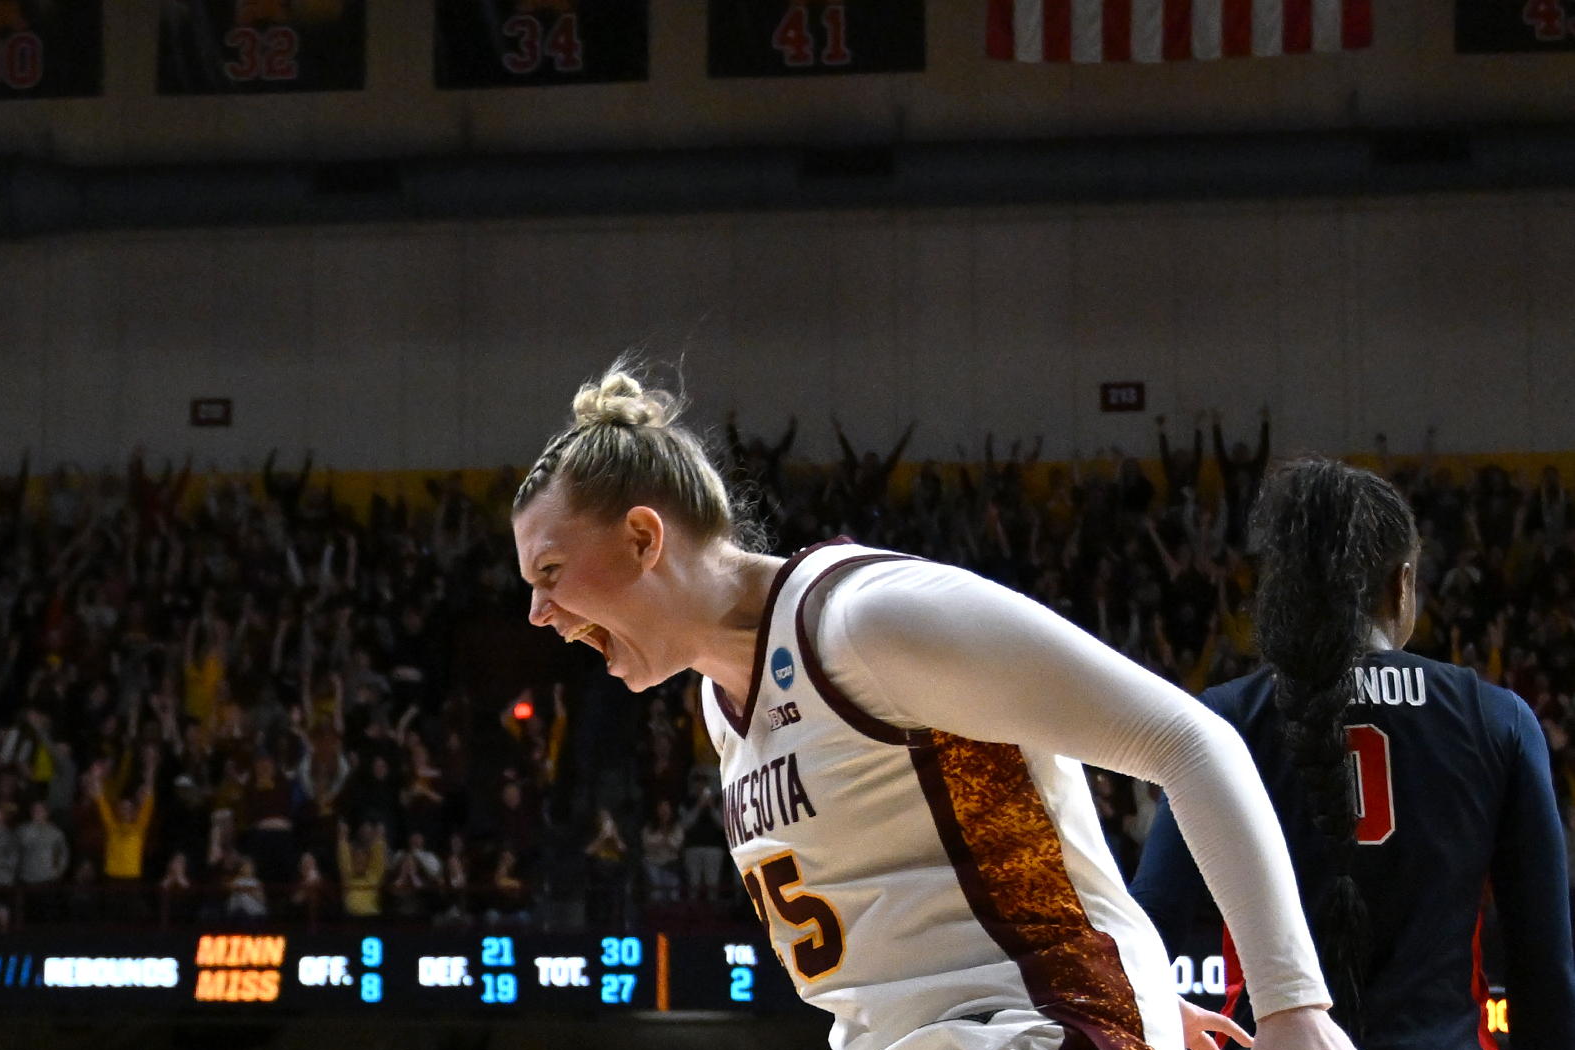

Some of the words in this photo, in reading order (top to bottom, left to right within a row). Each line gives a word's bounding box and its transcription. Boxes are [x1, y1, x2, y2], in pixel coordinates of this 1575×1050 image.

[224, 25, 299, 81] 32
[501, 13, 583, 74] 34
[771, 3, 852, 67] 41
[1348, 666, 1427, 706] NOU
[195, 935, 285, 967] MINN
[361, 937, 384, 967] 9
[481, 937, 516, 967] 21
[600, 936, 642, 967] 30
[44, 957, 178, 988] REBOUNDS
[418, 956, 474, 987] DEF.
[534, 957, 591, 987] TOT.
[194, 970, 281, 1001] MISS
[361, 972, 384, 1003] 8
[481, 973, 518, 1003] 19
[600, 973, 637, 1003] 27
[730, 967, 753, 1002] 2
